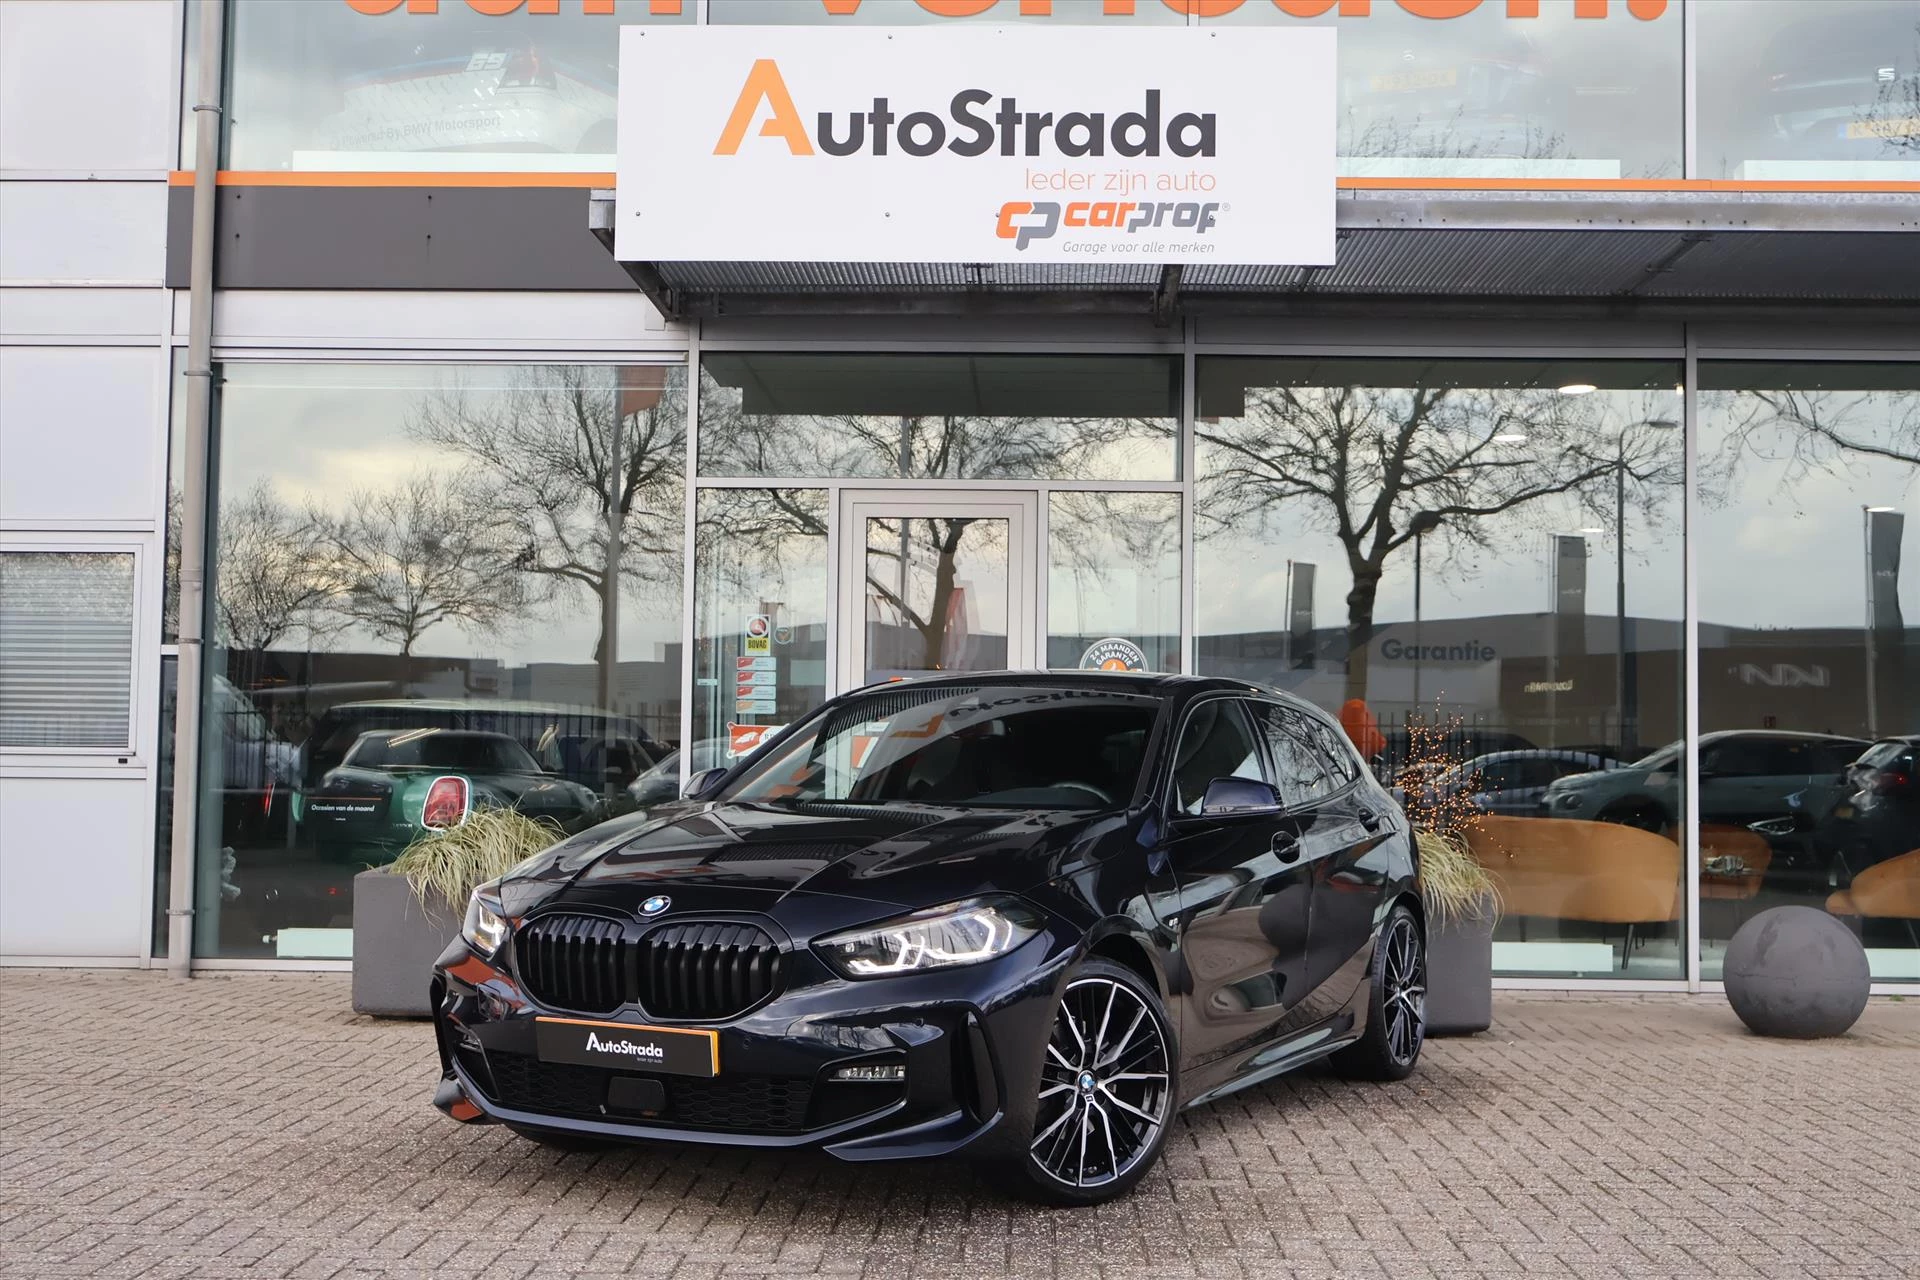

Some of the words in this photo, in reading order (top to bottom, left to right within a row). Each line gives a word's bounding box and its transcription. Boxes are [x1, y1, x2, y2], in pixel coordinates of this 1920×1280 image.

[712, 58, 1217, 158] AutoStrada
[403, 122, 431, 137] BMW
[434, 115, 502, 132] Motorsport
[1025, 167, 1096, 191] Ieder
[1104, 168, 1147, 196] zijn
[1156, 170, 1217, 191] auto
[1063, 241, 1108, 255] Garage
[1111, 243, 1139, 253] voor
[1142, 241, 1165, 253] alle
[1168, 241, 1215, 253] merken
[747, 639, 768, 649] BOVAG
[1089, 650, 1100, 661] 24
[1100, 643, 1140, 662] MAANDEN
[1381, 638, 1496, 662] Garantie
[1095, 651, 1134, 666] GARANTIE
[346, 804, 354, 812] de
[586, 1031, 664, 1058] AutoStrada
